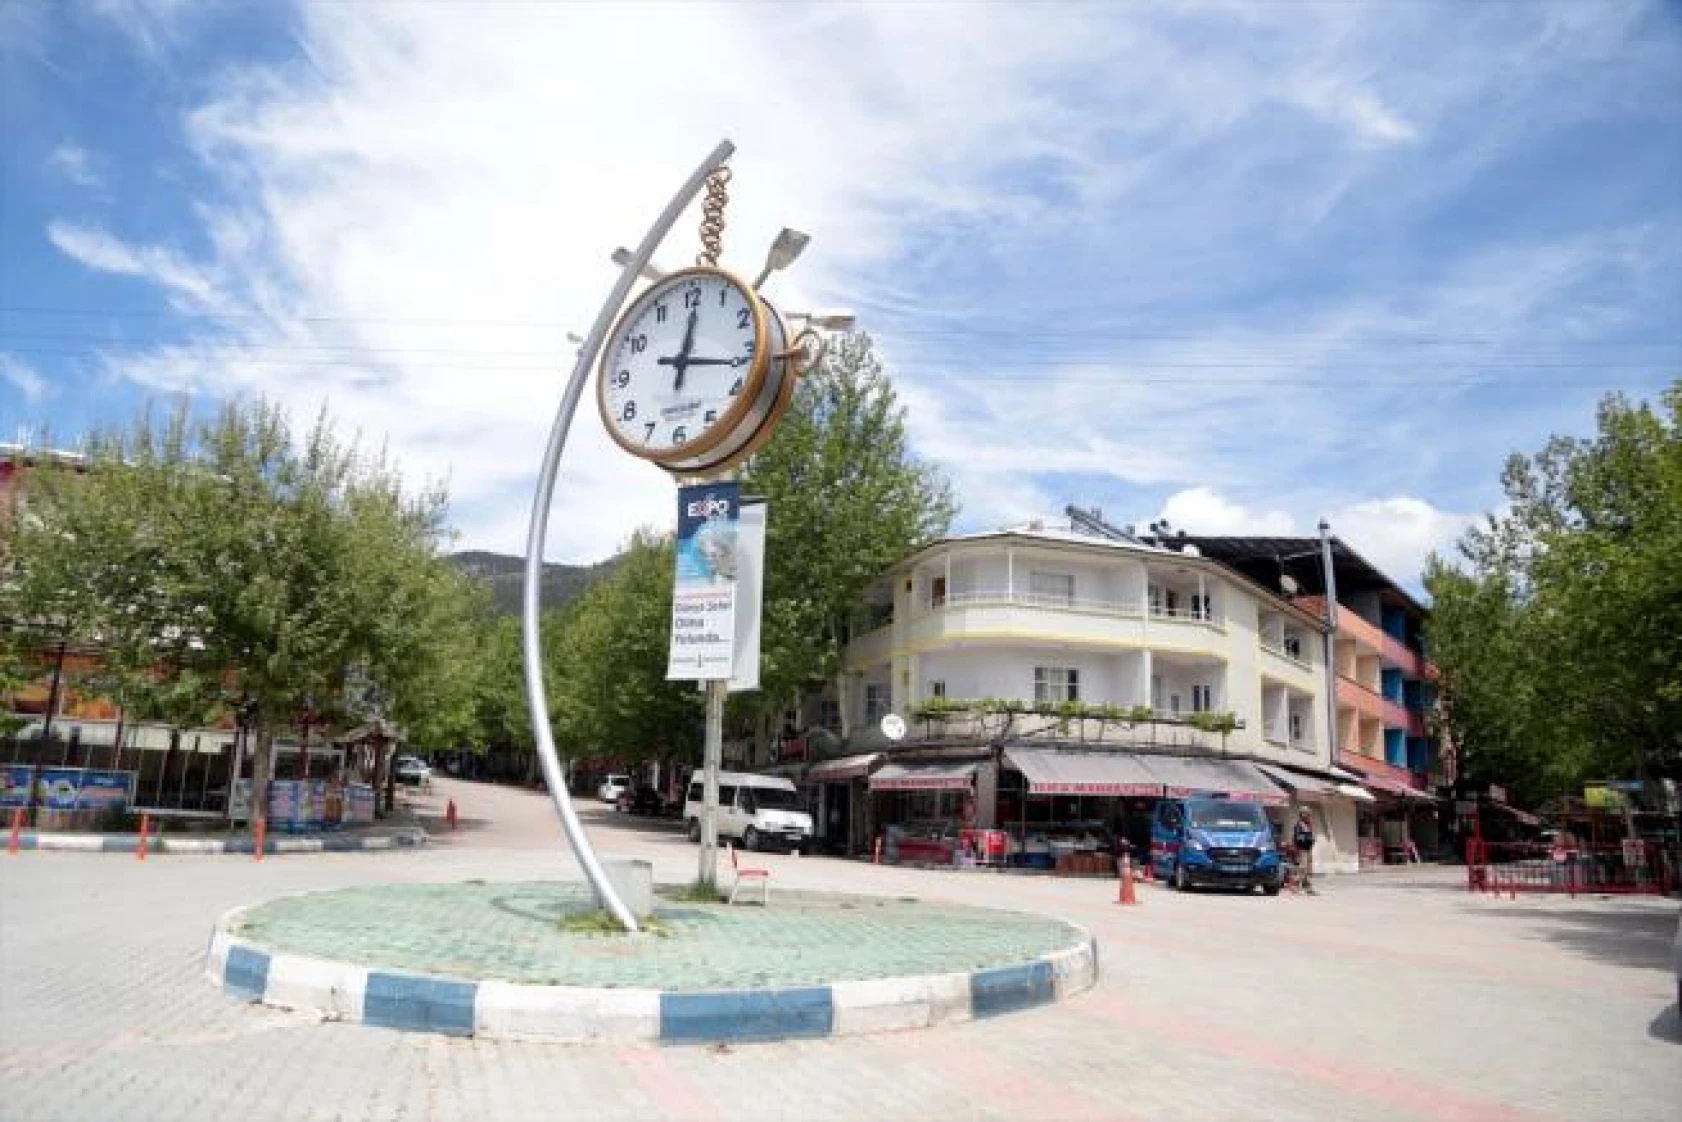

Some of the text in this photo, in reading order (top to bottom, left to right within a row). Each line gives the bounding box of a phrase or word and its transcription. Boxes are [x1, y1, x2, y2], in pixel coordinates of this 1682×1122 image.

[685, 287, 701, 308] 12
[719, 289, 726, 308] 1
[656, 305, 667, 324] 11
[737, 308, 751, 329] 2
[631, 334, 648, 353] 10
[618, 370, 630, 388] 9
[623, 400, 636, 421] 8
[644, 421, 656, 441] 7
[672, 425, 687, 444] 6
